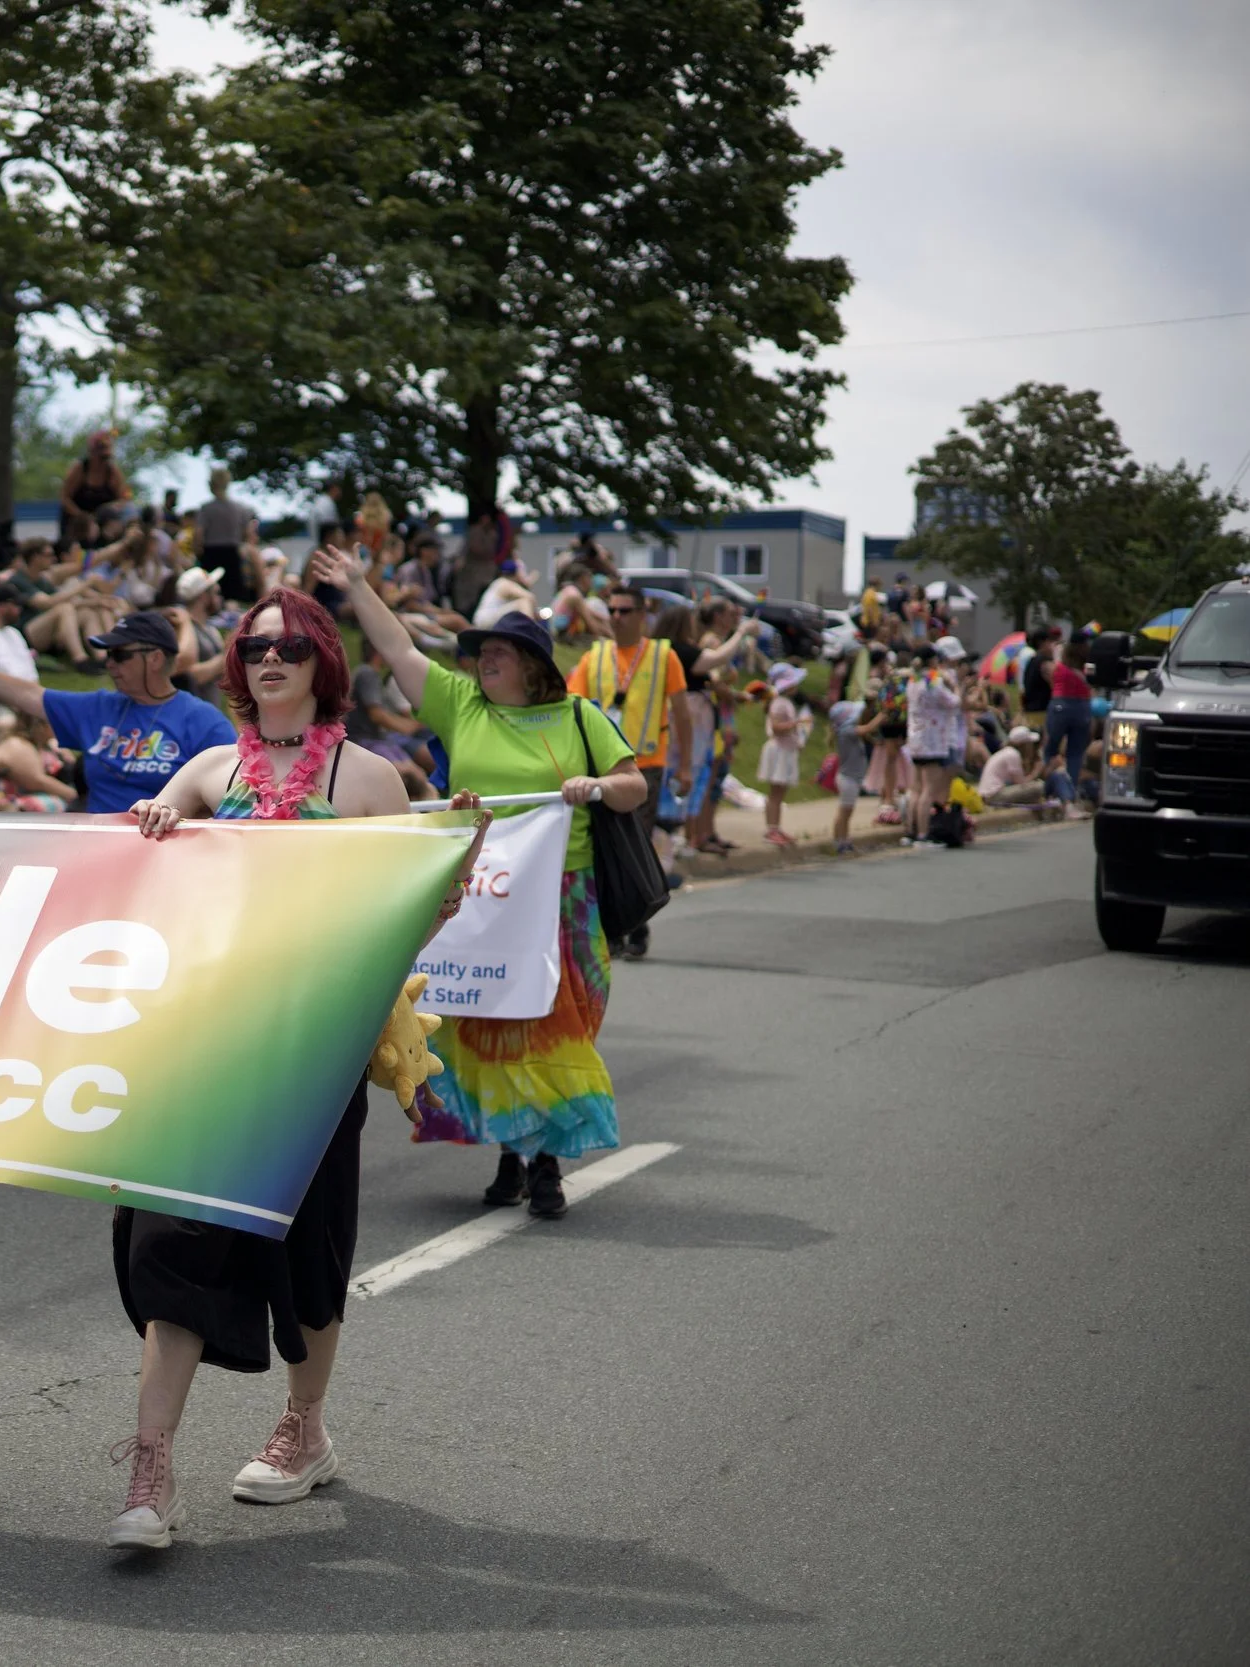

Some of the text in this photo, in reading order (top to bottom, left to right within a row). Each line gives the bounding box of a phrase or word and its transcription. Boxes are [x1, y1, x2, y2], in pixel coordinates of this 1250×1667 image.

[87, 726, 180, 760] Pride
[123, 760, 172, 774] nscc
[410, 960, 507, 981] aculty and
[434, 987, 482, 1005] Staff
